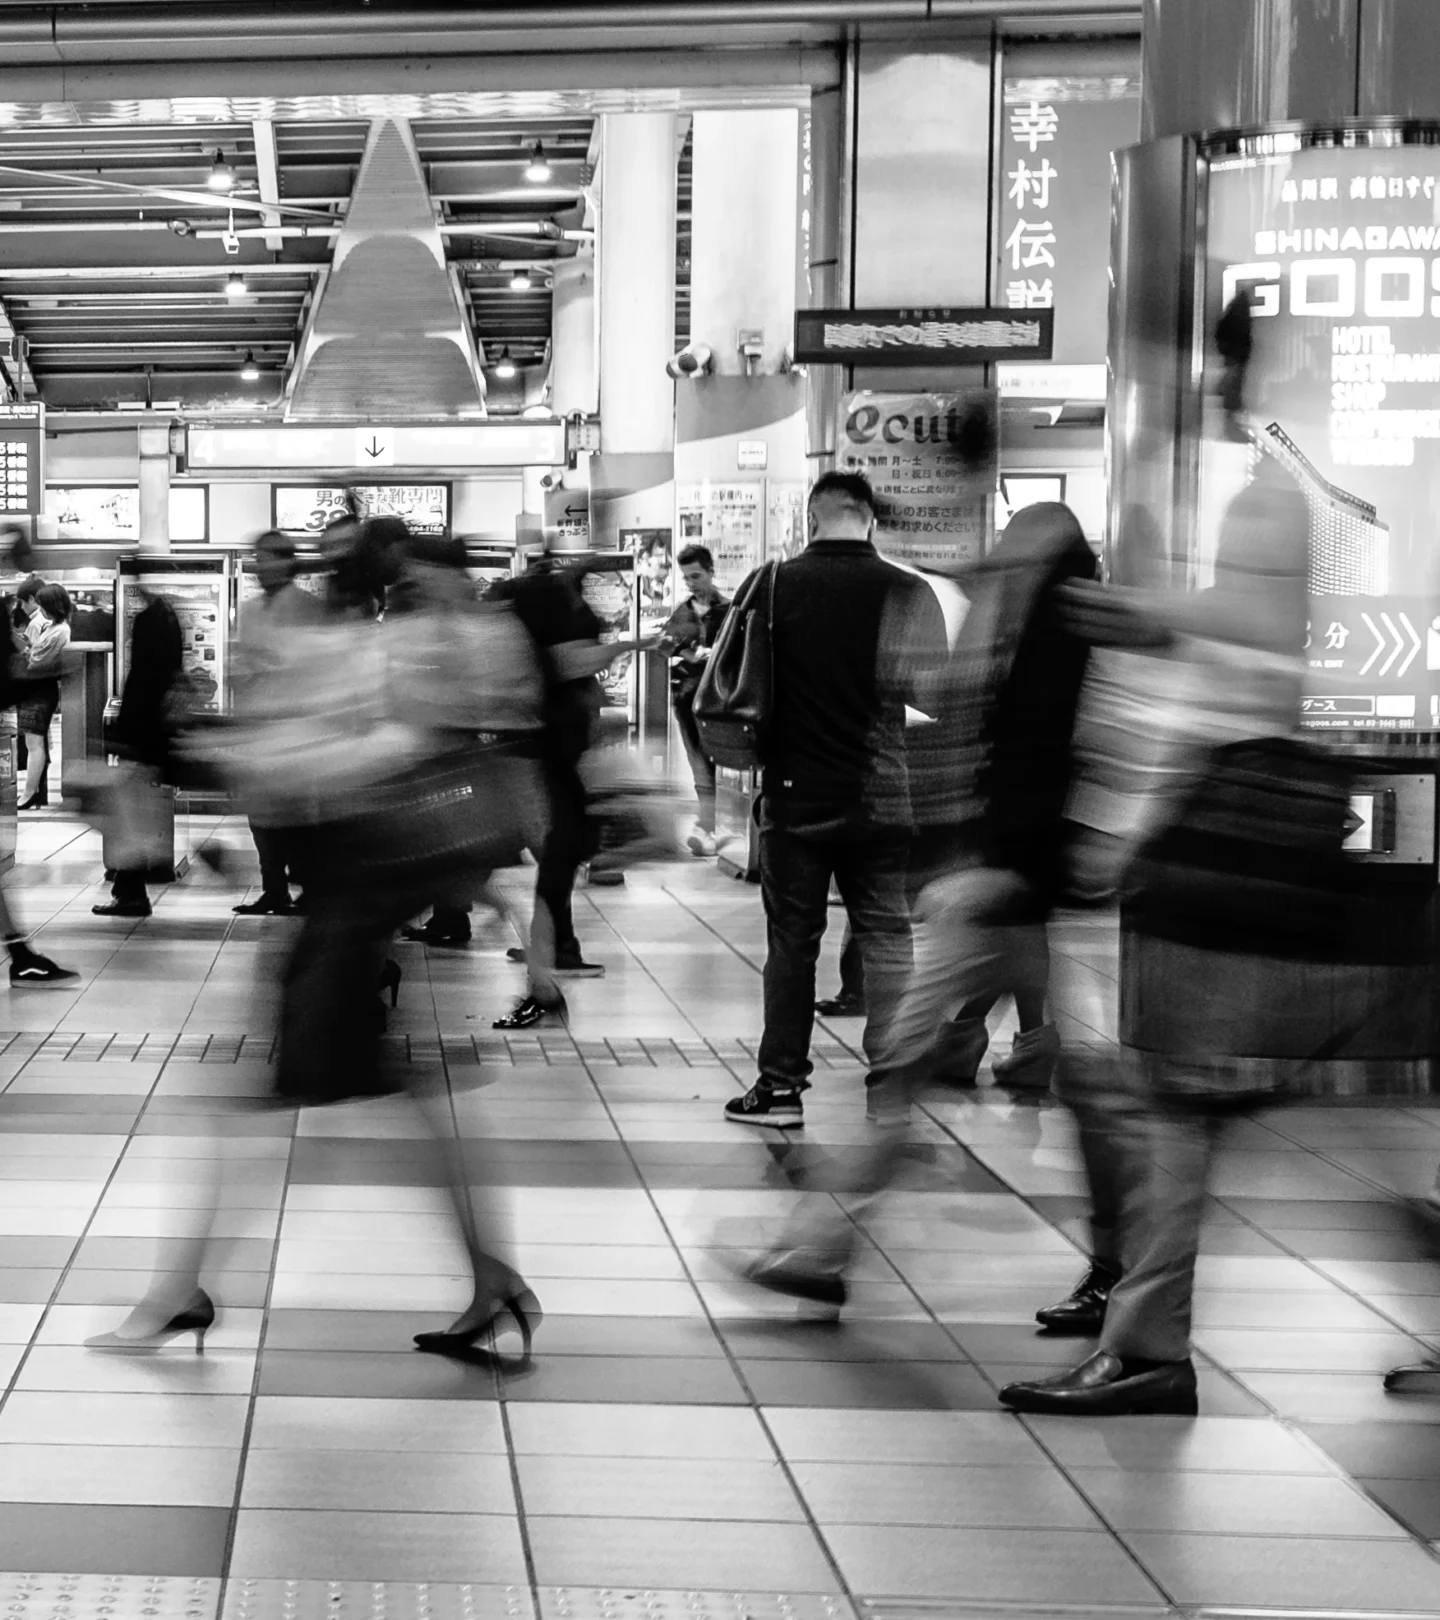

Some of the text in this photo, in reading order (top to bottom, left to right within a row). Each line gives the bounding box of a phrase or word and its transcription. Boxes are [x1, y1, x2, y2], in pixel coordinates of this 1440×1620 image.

[1005, 101, 1059, 309] 幸村伝説
[1222, 257, 1440, 318] GOO
[845, 404, 964, 446] ecut
